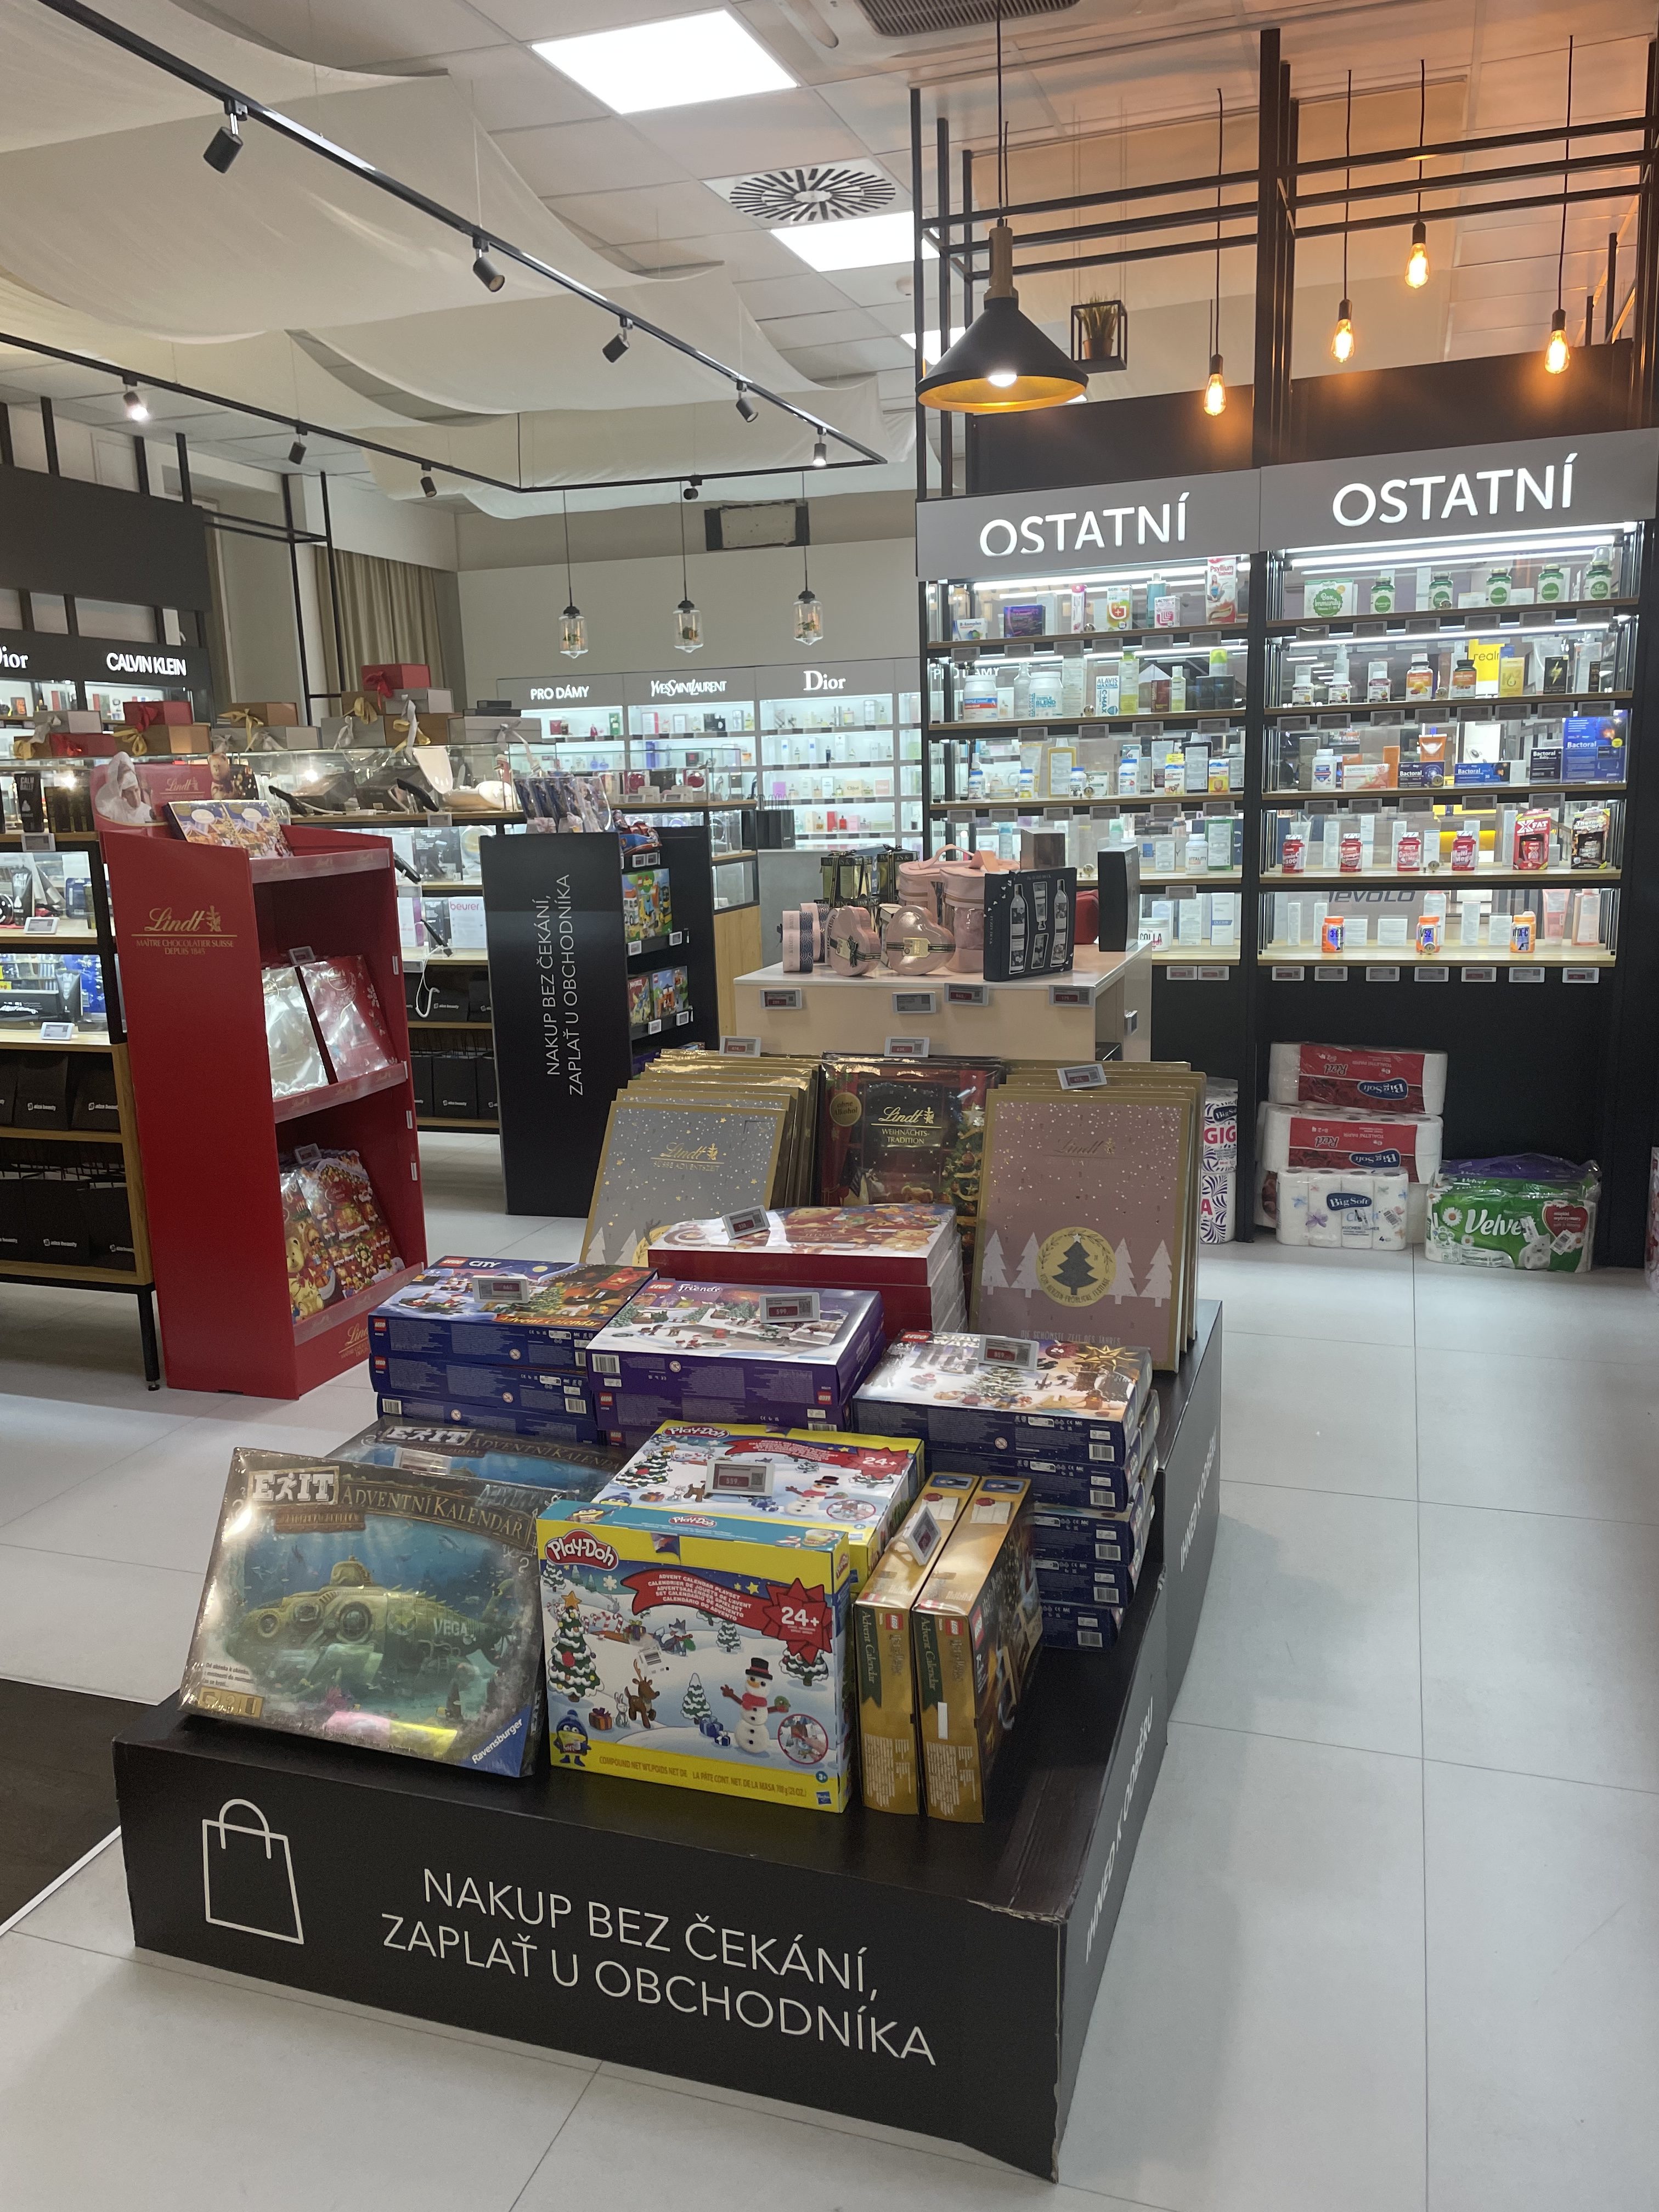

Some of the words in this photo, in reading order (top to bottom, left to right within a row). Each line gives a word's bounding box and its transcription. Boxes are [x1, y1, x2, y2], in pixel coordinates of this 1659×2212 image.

[1333, 453, 1578, 527] OSTATNÍ
[980, 492, 1190, 557] OSTATNÍ
[0, 646, 29, 669] ior
[106, 652, 152, 674] CALVIN
[153, 656, 187, 676] KLEIN
[803, 670, 846, 691] Dior
[531, 687, 554, 701] PRO
[556, 684, 590, 699] DÁMY
[450, 901, 479, 910] beurer
[144, 907, 205, 932] Lindt
[137, 938, 161, 947] MAÎTRE
[162, 939, 211, 948] CHOCOLATIER
[211, 940, 234, 948] SUISSE
[532, 894, 553, 969] ČEKÁNÍ,
[556, 874, 578, 1007] OBCHODNÍKA
[165, 947, 189, 955] DEPUIS
[541, 974, 555, 1007] BEZ
[565, 1012, 579, 1024] U
[543, 1013, 560, 1075] NAKUP
[562, 1030, 584, 1096] ZAPLAŤ
[1323, 1063, 1348, 1076] Red
[878, 1107, 924, 1123] Lindt
[882, 1128, 930, 1137] WEIHNACHTS-
[887, 1136, 924, 1144] TRADITION
[1314, 1136, 1339, 1148] Red
[660, 1142, 707, 1160] Lindt
[678, 1283, 721, 1293] Friends
[545, 1318, 601, 1327] Calendar
[1020, 1329, 1030, 1340] DIE
[1033, 1330, 1064, 1340] SCHÖNSTE
[1067, 1333, 1081, 1342] ZEIT
[1084, 1335, 1095, 1343] DES
[1099, 1335, 1121, 1345] JAHRES
[664, 1426, 729, 1438] Play-Doh
[862, 1456, 897, 1466] 24+
[252, 1472, 334, 1503] EXIT
[341, 1485, 432, 1517] ADVENTNÍ
[434, 1496, 523, 1541] KALENDÁŘ
[669, 1516, 716, 1527] Play-Doh
[1181, 1502, 1197, 1573] IHNED
[1197, 1483, 1201, 1516] K
[547, 1537, 616, 1567] Play-Doh
[683, 1577, 714, 1589] CALENDAR
[715, 1587, 741, 1600] PLAYSET
[433, 1617, 468, 1636] VEGA
[781, 1606, 820, 1628] 24+
[862, 1610, 873, 1638] Advent
[890, 1615, 899, 1629] LEGO
[950, 1620, 958, 1635] LEGO
[921, 1616, 933, 1644] Advent
[865, 1638, 875, 1684] Calendar
[925, 1645, 936, 1690] Calendar
[470, 1717, 524, 1764] Ravensburger
[600, 1756, 630, 1768] COMPOUND
[692, 1771, 699, 1780] LA
[1086, 1840, 1116, 1965] IHNED
[1116, 1807, 1124, 1853] K
[1124, 1696, 1154, 1821] ODBĚRU
[423, 1867, 572, 1929] NAKUP
[588, 1900, 672, 1953] BEZ
[685, 1914, 879, 2002] ČEKÁNÍ,
[380, 1912, 538, 1978] ZAPLAŤ
[551, 1954, 578, 1988] U
[594, 1959, 936, 2066] OBCHODNÍKA
